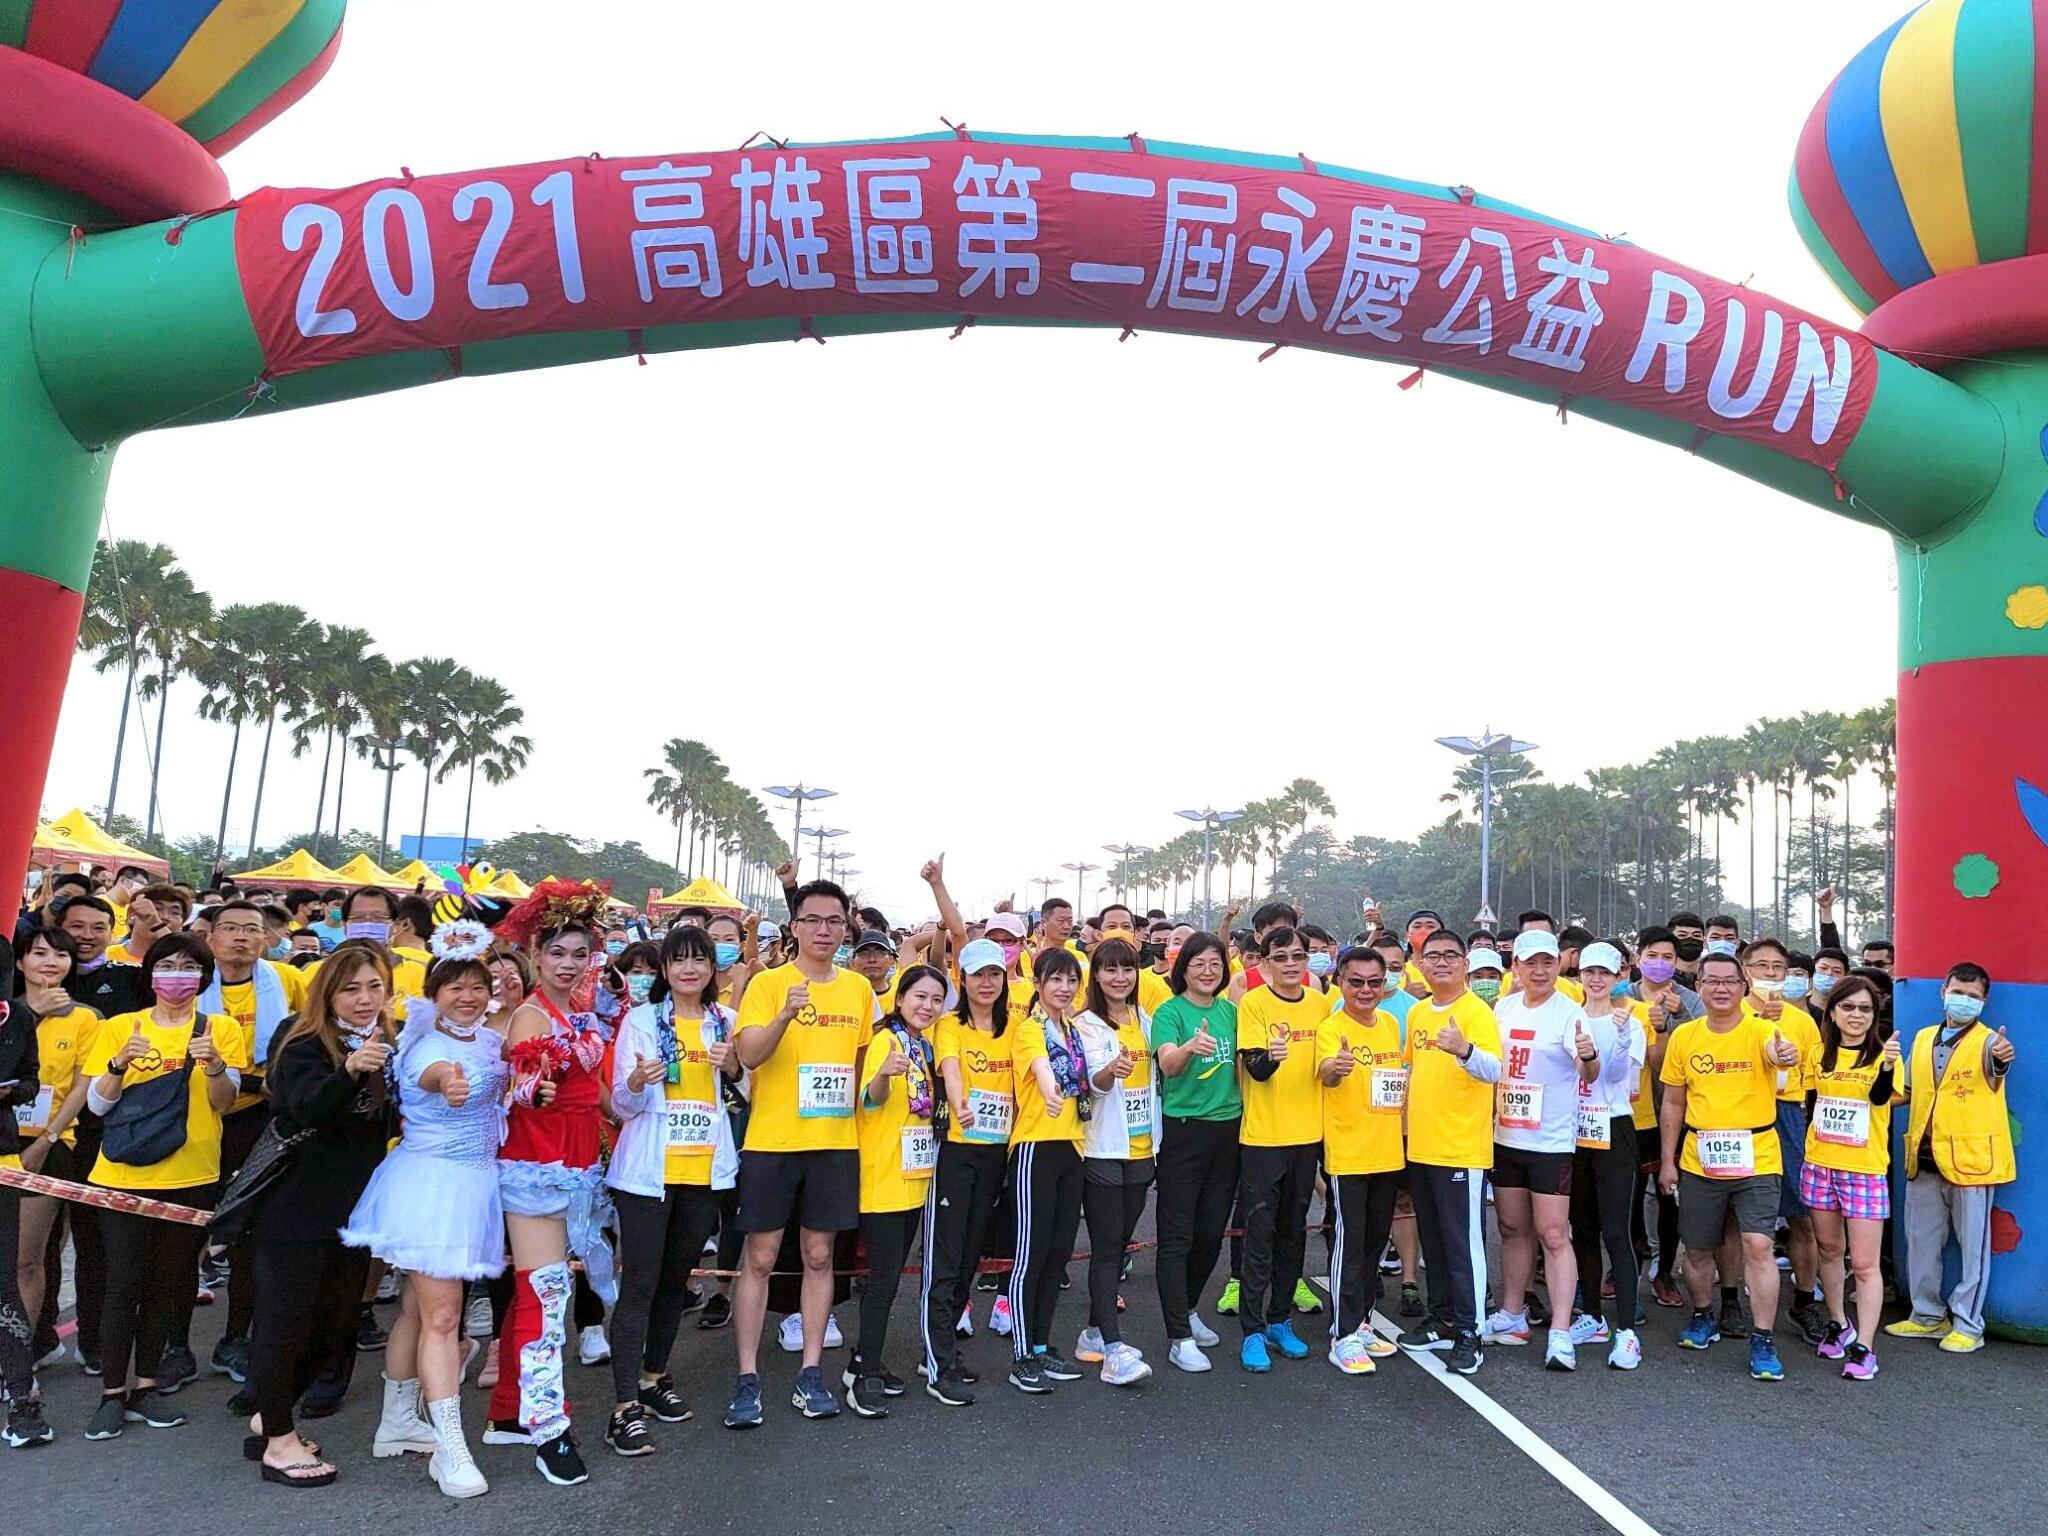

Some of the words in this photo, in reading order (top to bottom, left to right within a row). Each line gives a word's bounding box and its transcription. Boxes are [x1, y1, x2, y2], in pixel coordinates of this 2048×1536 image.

[282, 171, 586, 337] 2021
[621, 155, 1612, 373] 高雄區第二屆永慶公益
[1625, 270, 1852, 445] RUN
[1508, 1028, 1536, 1080] 一起
[812, 1076, 847, 1089] 2217
[1502, 1093, 1531, 1105] 1090
[978, 1102, 1010, 1118] 2218
[1822, 1106, 1857, 1121] 1027
[668, 1113, 711, 1128] 3809
[1706, 1140, 1741, 1152] 1054
